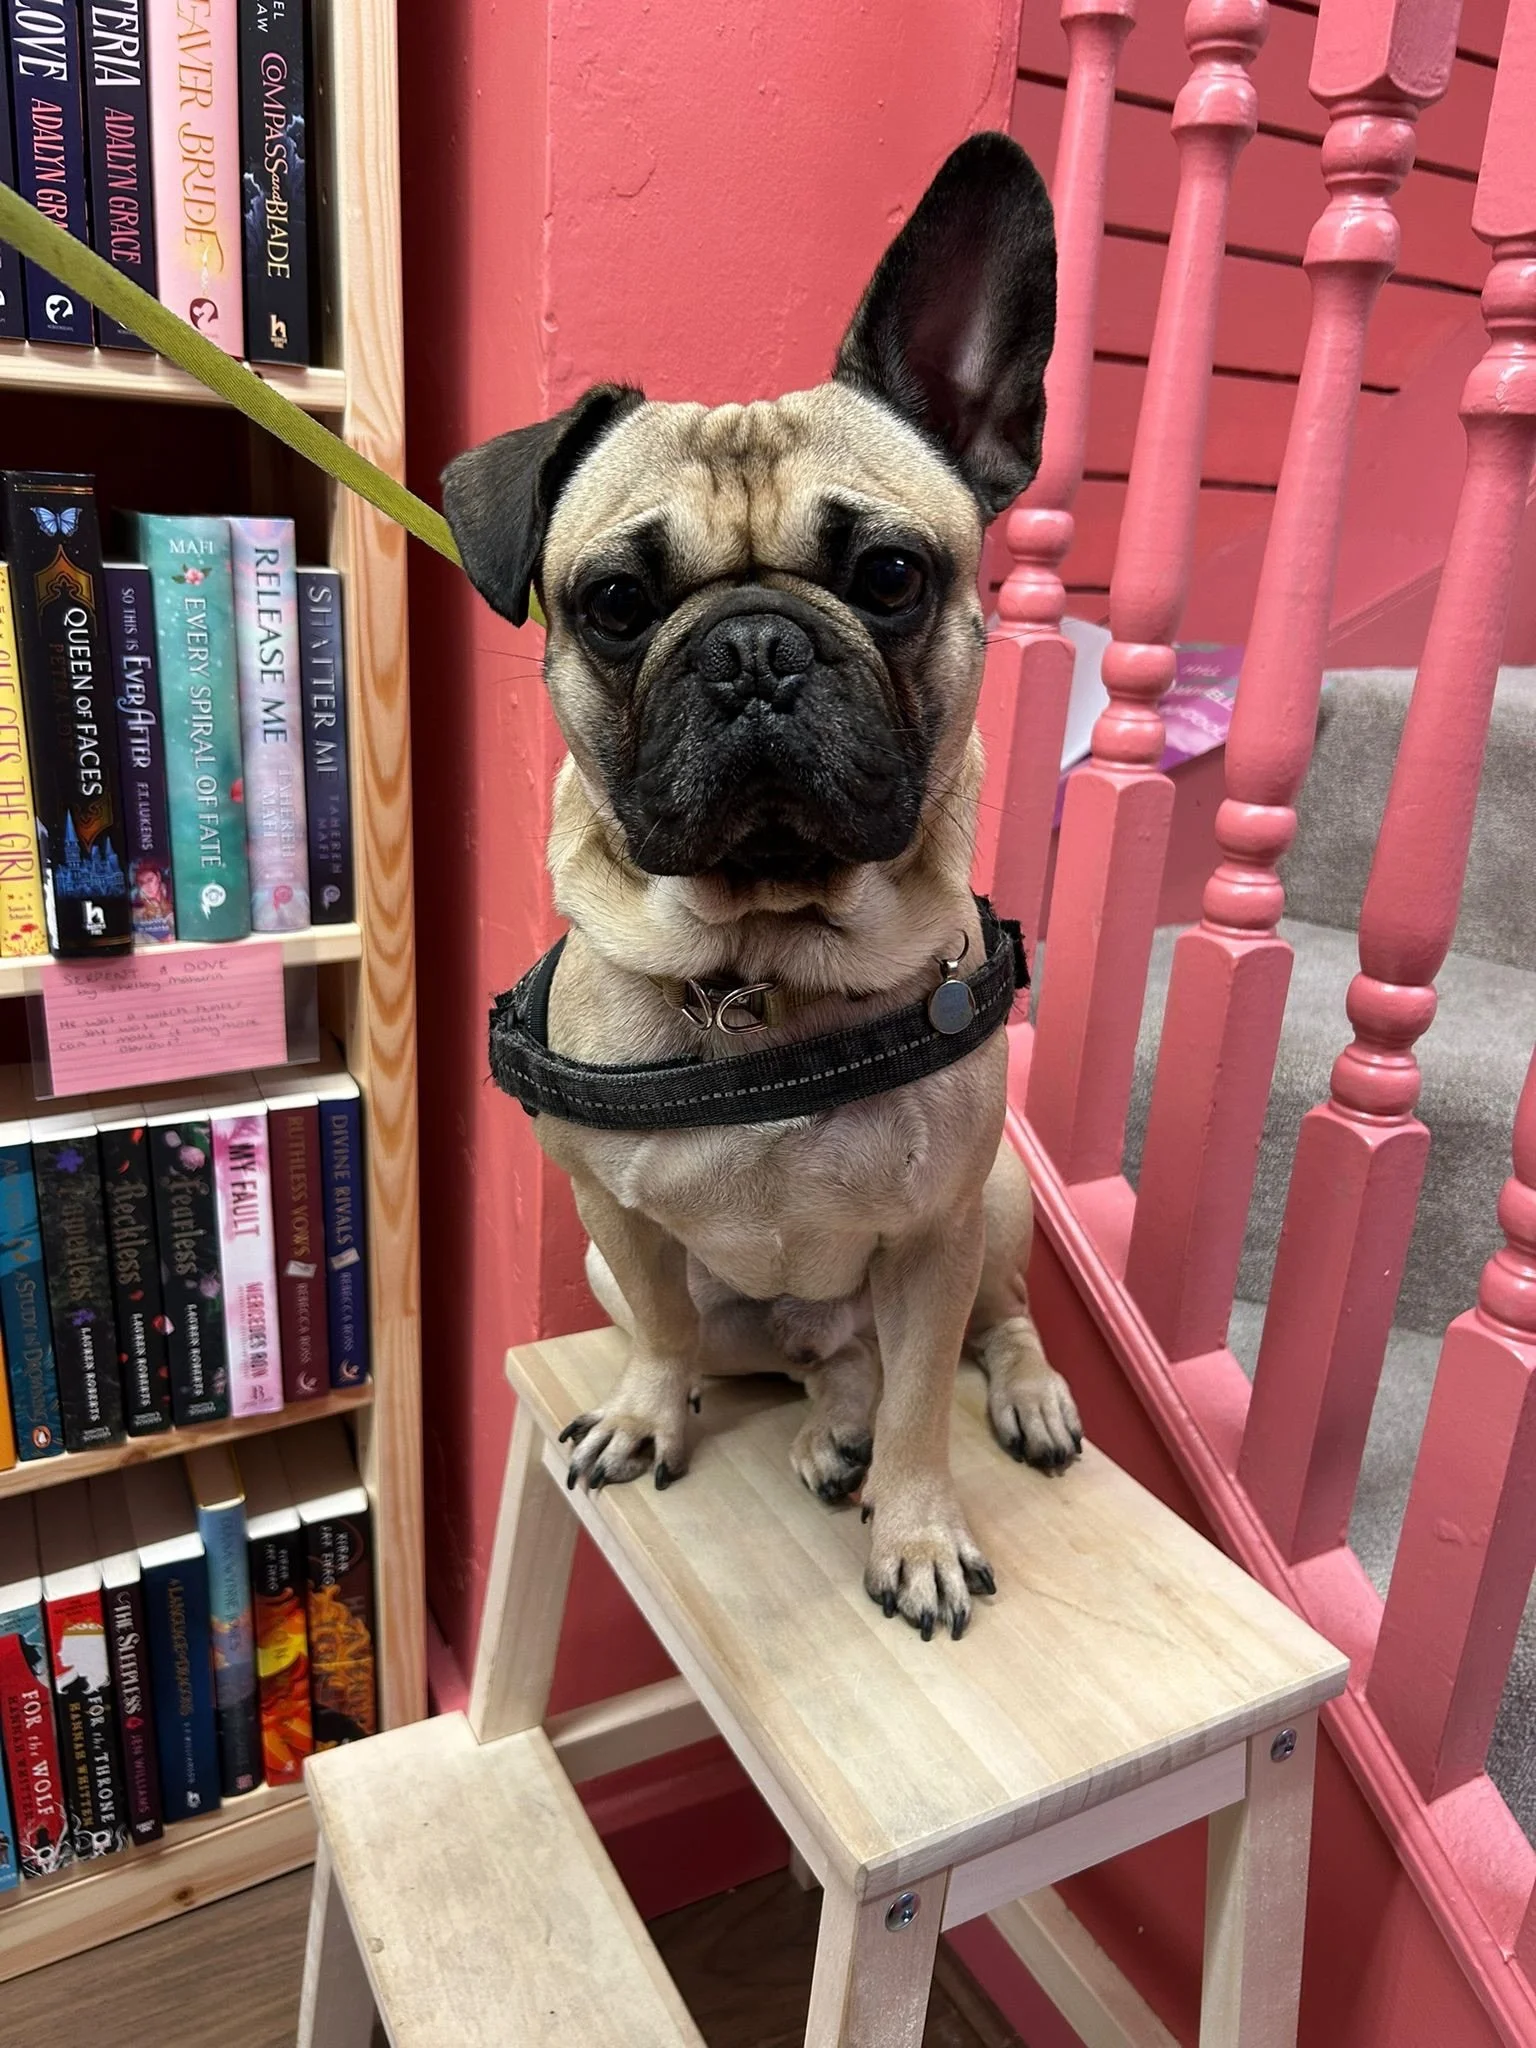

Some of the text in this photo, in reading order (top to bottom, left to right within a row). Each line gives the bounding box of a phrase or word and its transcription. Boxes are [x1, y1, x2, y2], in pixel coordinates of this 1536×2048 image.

[260, 52, 289, 174] COMPASS
[31, 98, 68, 229] ADALYN GRA
[104, 107, 142, 265] ADALYN GRACE
[177, 122, 224, 274] BRIDE
[265, 200, 290, 279] BLADE
[169, 539, 215, 554] MAFI
[121, 588, 134, 604] SO
[123, 608, 138, 634] THIS
[125, 639, 138, 651] IS
[254, 547, 288, 744] RELEASE ME
[63, 607, 103, 796] QUEEN OF FACES
[308, 585, 338, 778] SHATTER ME
[184, 597, 222, 868] EVERY SPIRAL OF FATE
[138, 803, 154, 851] LUKENS
[262, 788, 278, 838] MAFI
[277, 769, 295, 859] TAHEREH
[317, 818, 329, 860] MAFI
[329, 795, 343, 874] TAHEREH
[184, 959, 230, 973] DOVE
[229, 1143, 260, 1237] MY FAULT
[287, 1115, 310, 1256] RUTHLESS VOWS
[331, 1114, 354, 1245] DIVINE RIVALS
[18, 1279, 37, 1329] STUDY
[186, 1304, 200, 1345] LAUREN
[244, 1281, 265, 1348] MERCEDES
[295, 1282, 311, 1363] REBECCA ROSS
[339, 1272, 352, 1322] REBECCA
[80, 1327, 95, 1371] LAUREN
[131, 1313, 147, 1356] LAUREN
[85, 1372, 100, 1422] ROBERTS
[136, 1358, 151, 1407] ROBERTS
[190, 1347, 204, 1396] ROBERTS
[118, 1632, 143, 1715] SLEEPLESS
[87, 1694, 105, 1730] FOR
[22, 1690, 42, 1729] FOR
[32, 1760, 54, 1816] WOLF
[68, 1702, 94, 1828] HANNAH WHITTEN
[95, 1751, 116, 1823] THRONE
[133, 1758, 150, 1813] WILLIAMS
